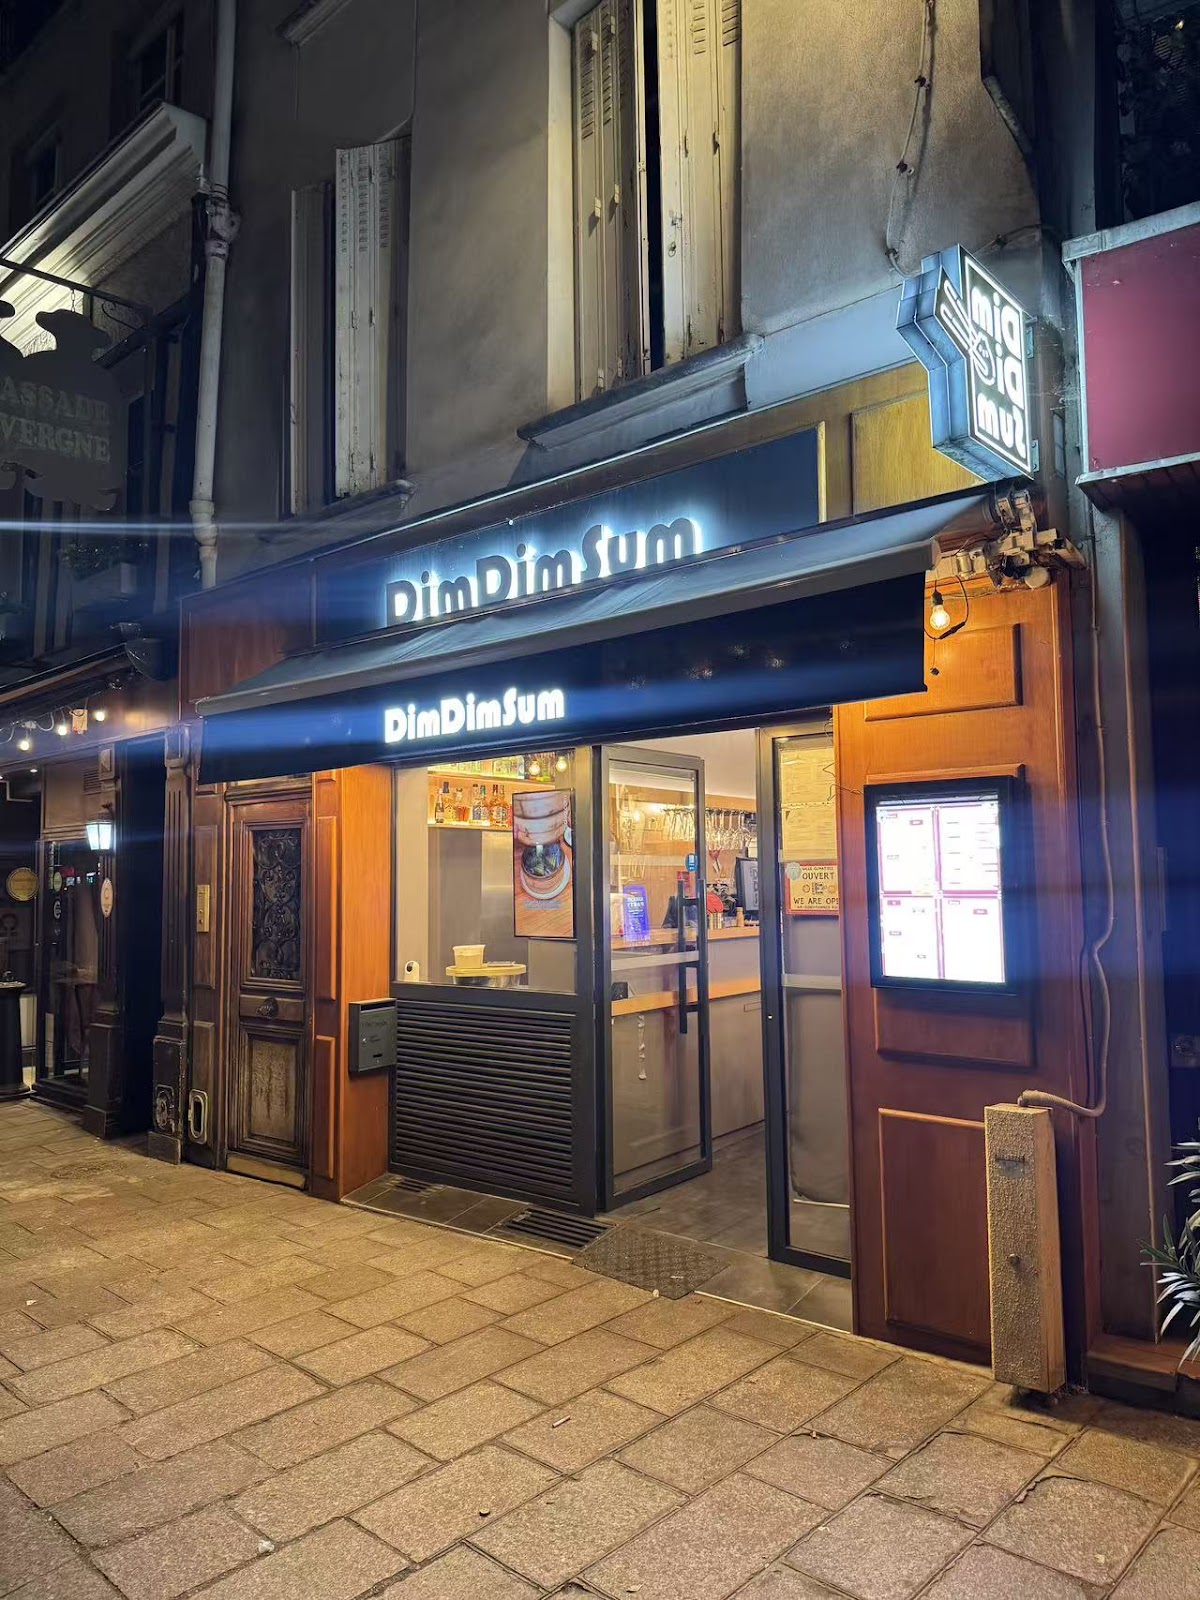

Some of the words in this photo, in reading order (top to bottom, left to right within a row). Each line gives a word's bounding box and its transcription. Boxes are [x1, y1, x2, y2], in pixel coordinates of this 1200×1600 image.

[0, 376, 111, 427] ASSADE
[0, 412, 111, 464] VERGNE
[385, 516, 699, 628] DimDimSum
[384, 687, 565, 744] DimDimSum
[794, 897, 805, 905] WE
[808, 897, 822, 905] ARE
[826, 897, 839, 905] OPE
[802, 872, 834, 880] OUVERT
